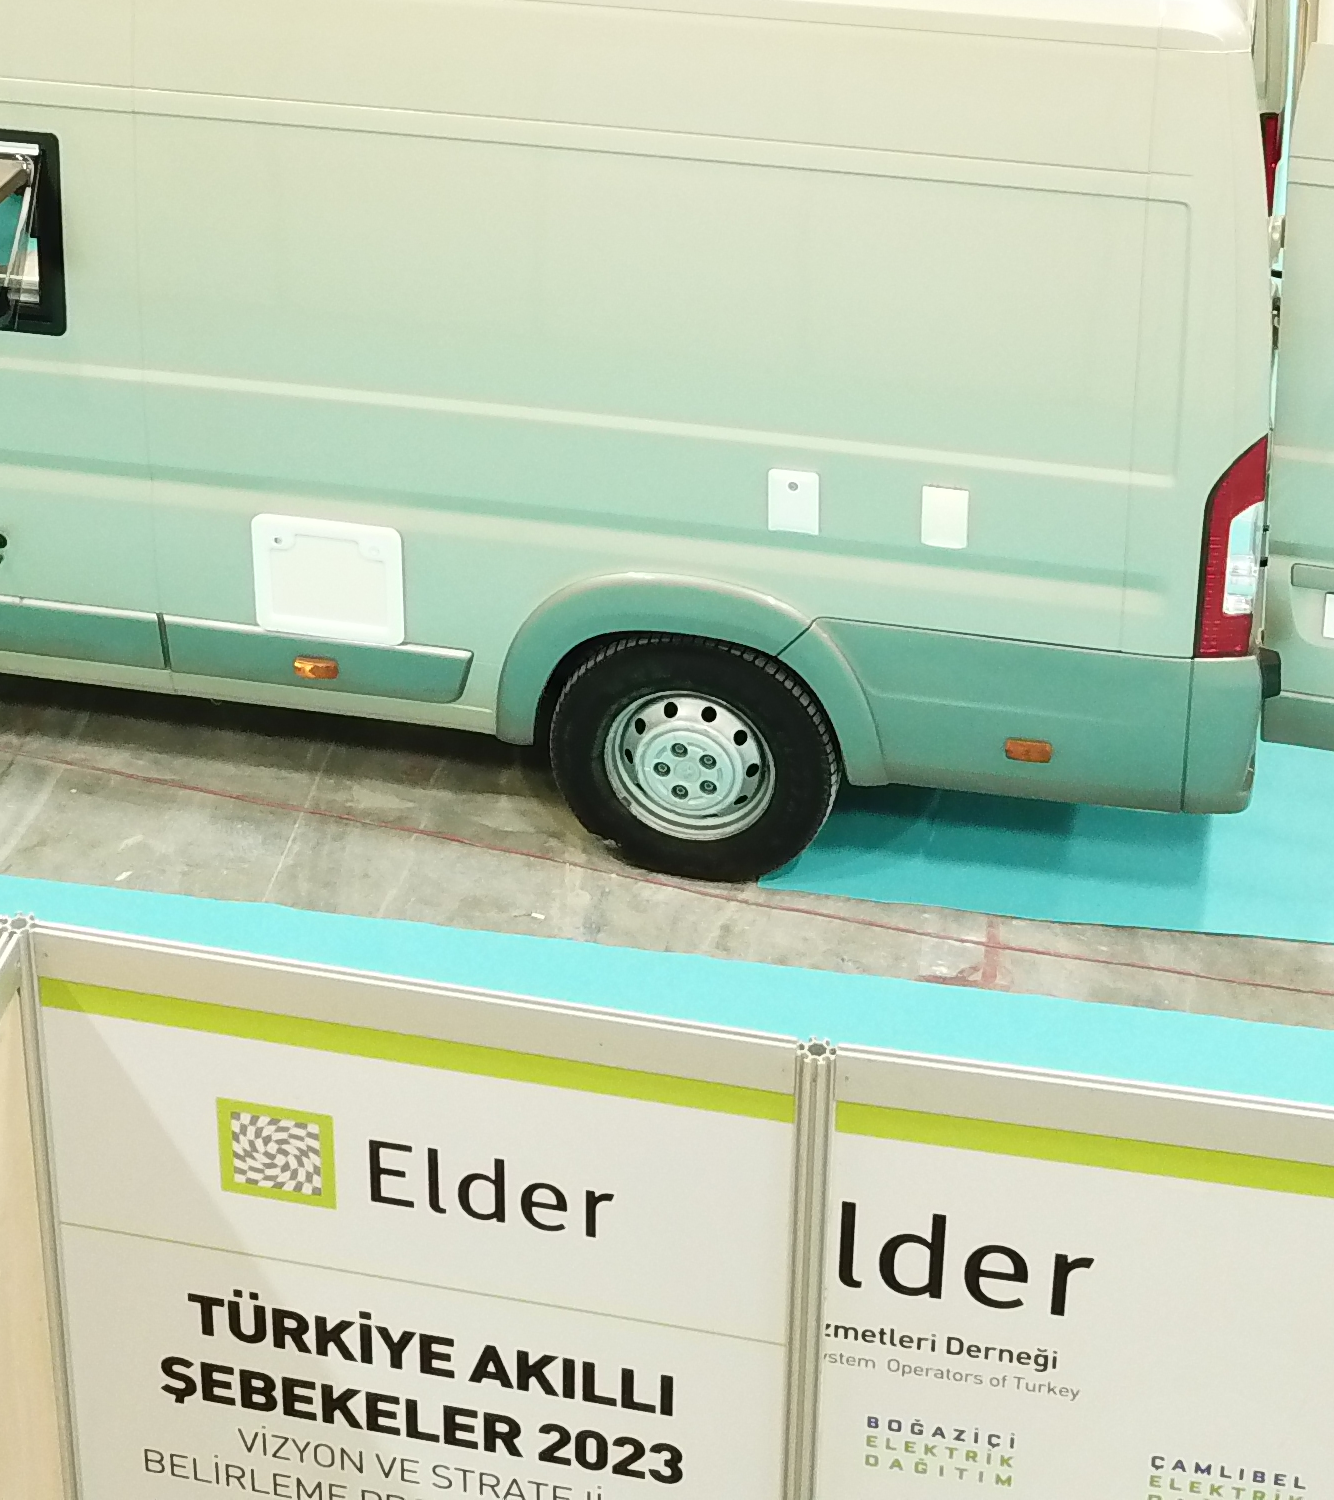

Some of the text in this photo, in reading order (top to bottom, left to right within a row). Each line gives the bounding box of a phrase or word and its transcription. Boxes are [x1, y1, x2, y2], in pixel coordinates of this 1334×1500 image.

[368, 1138, 616, 1240] Elder
[187, 1288, 674, 1417] TÜRKİYE AKILLI
[946, 1335, 1059, 1373] Derneği
[886, 1357, 984, 1386] Operators
[989, 1374, 1007, 1389] of
[1013, 1375, 1081, 1402] Turkey
[160, 1355, 684, 1485] ŞEBEKELER 2023
[865, 1414, 1018, 1451] BOĞAZİÇİ
[237, 1426, 365, 1475] VİZYON
[374, 1453, 420, 1484] VE
[864, 1452, 1014, 1489] DAĞITIM
[865, 1434, 1015, 1470] ELEKTRİK
[1149, 1454, 1308, 1491] ÇAMLIBEL
